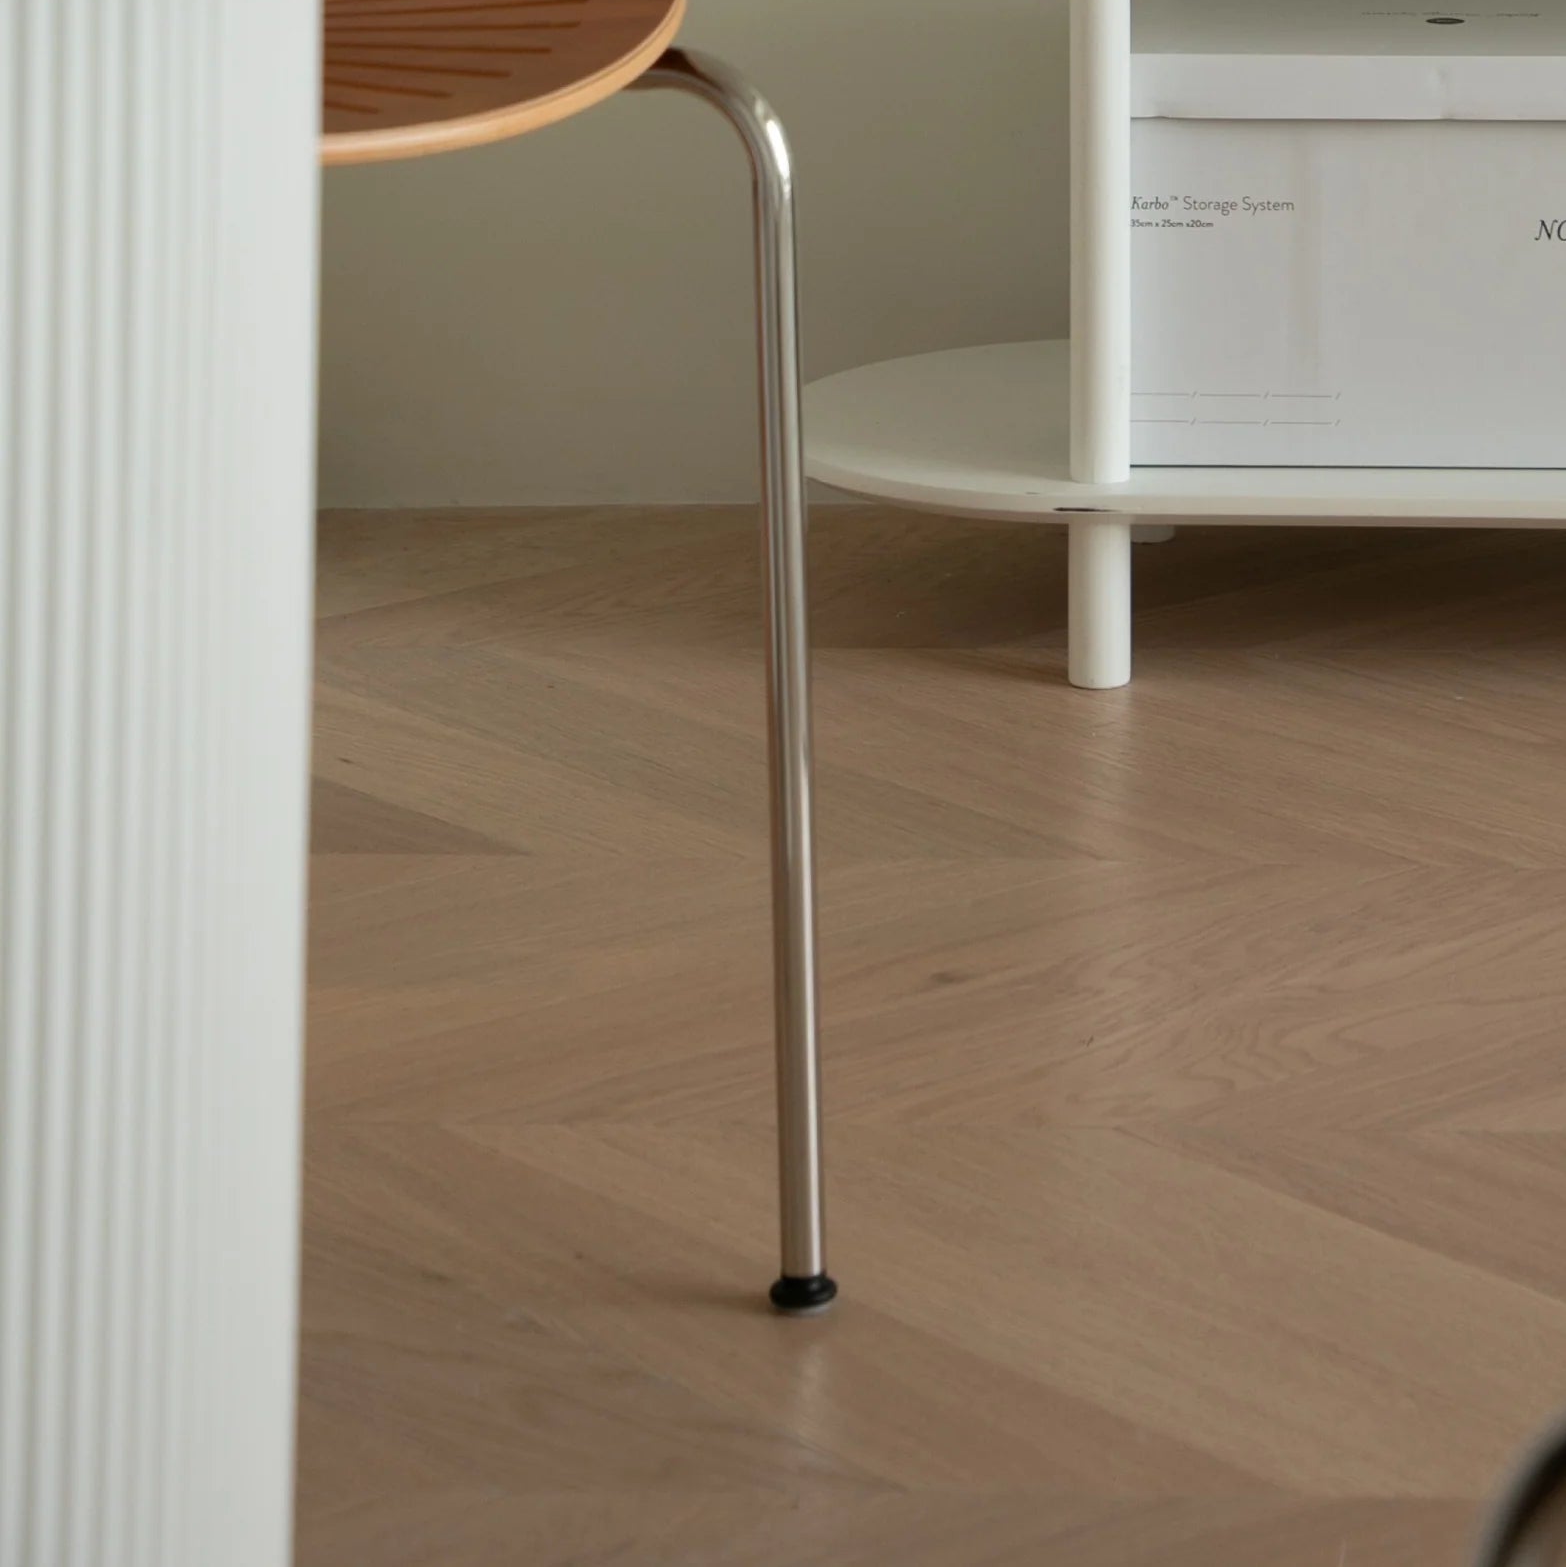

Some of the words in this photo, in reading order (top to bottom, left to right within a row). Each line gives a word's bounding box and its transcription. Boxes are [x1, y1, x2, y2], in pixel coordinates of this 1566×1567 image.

[1183, 196, 1238, 216] Storage
[1242, 195, 1295, 215] System
[1161, 219, 1184, 228] 25cm
